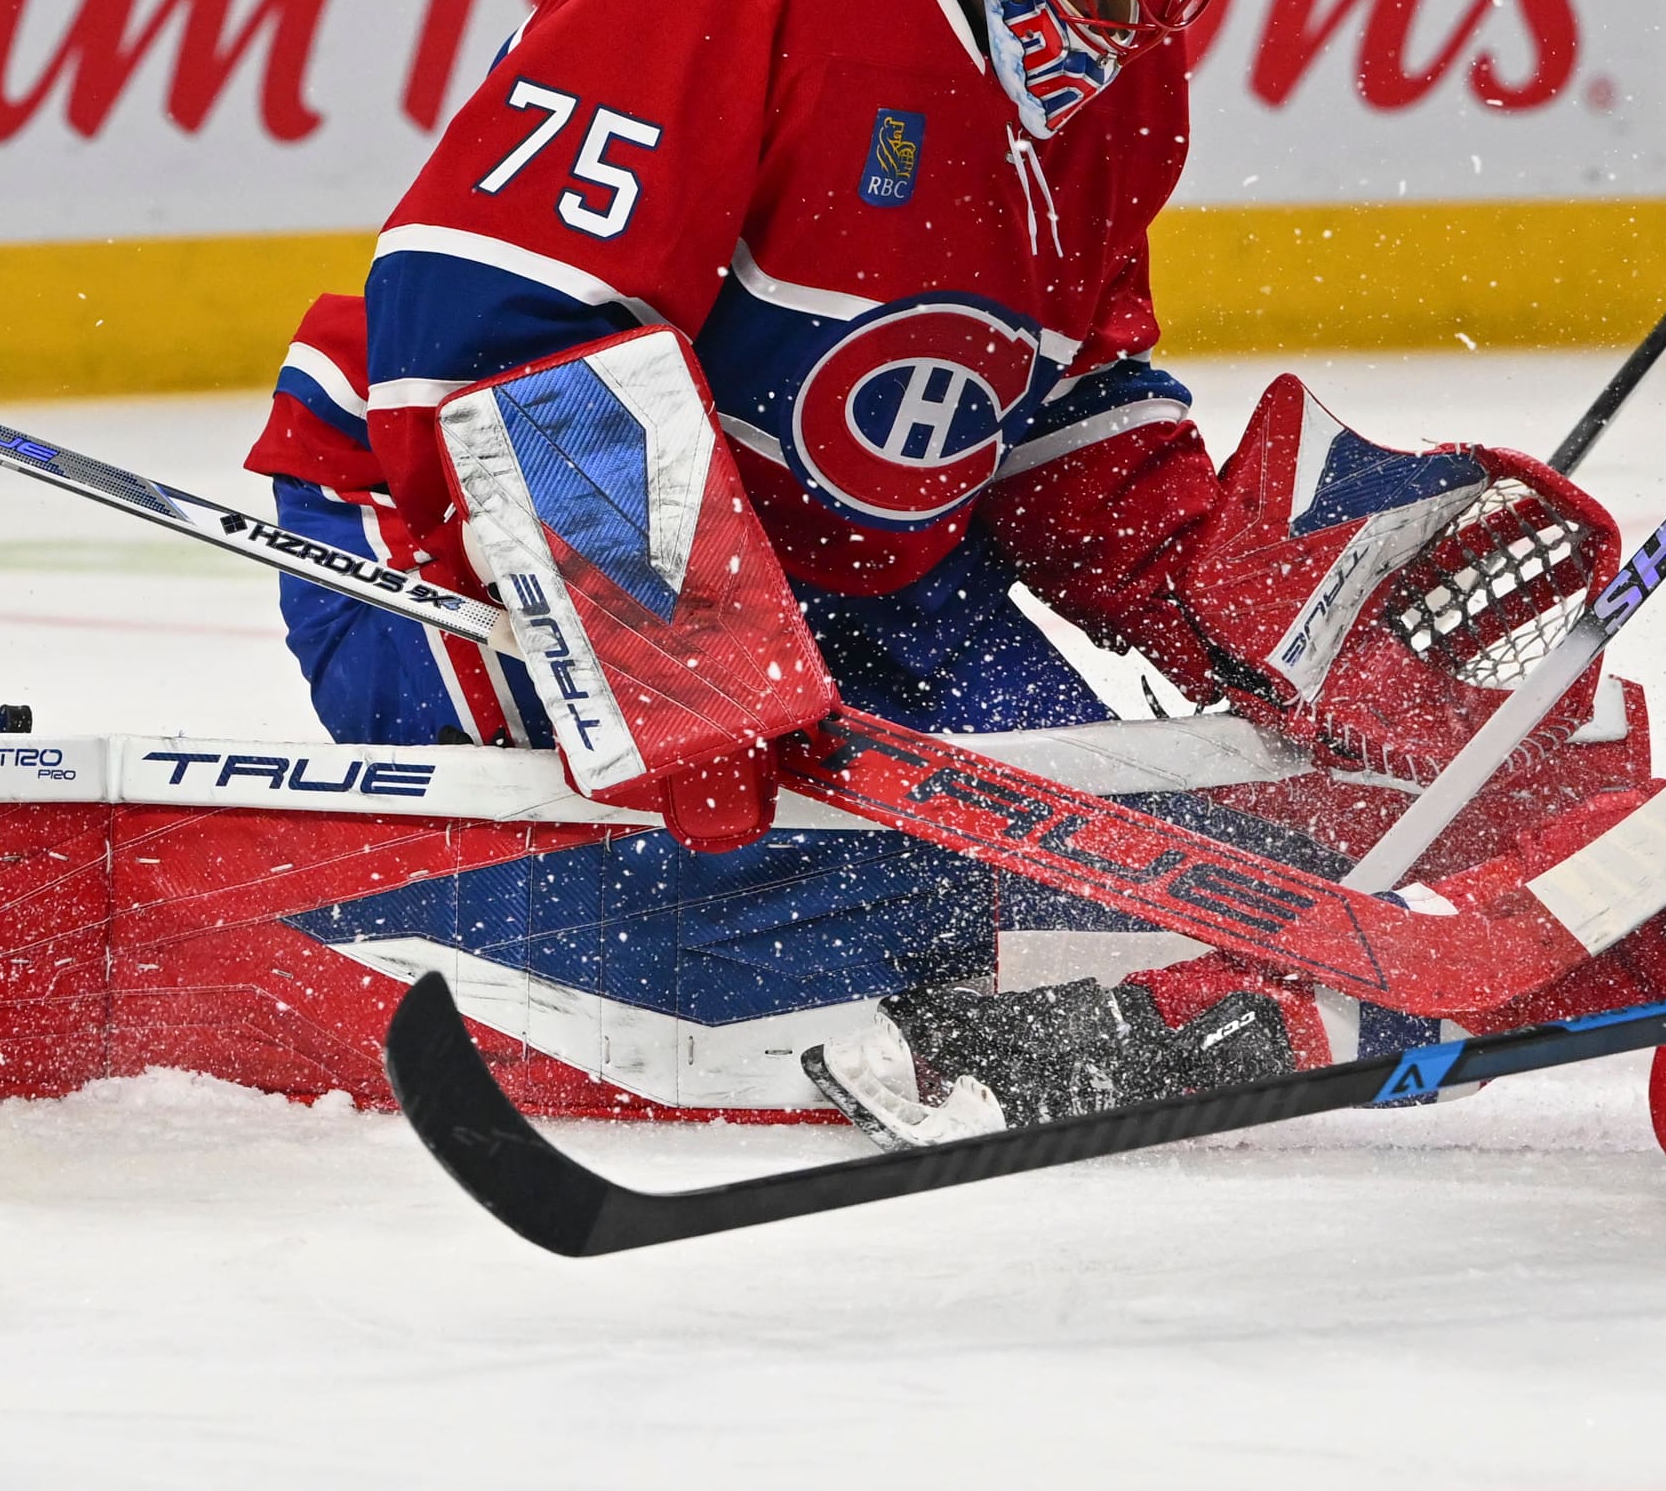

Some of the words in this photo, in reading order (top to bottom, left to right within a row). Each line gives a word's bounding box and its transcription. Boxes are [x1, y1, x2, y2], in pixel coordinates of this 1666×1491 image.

[472, 75, 664, 241] 75
[867, 175, 909, 200] RBC
[1281, 545, 1370, 668] TRUE
[509, 572, 602, 753] TRUE
[36, 768, 77, 782] PRO
[141, 750, 436, 798] TRUE
[820, 723, 1314, 934] TRUE
[1200, 1010, 1257, 1050] CCM
